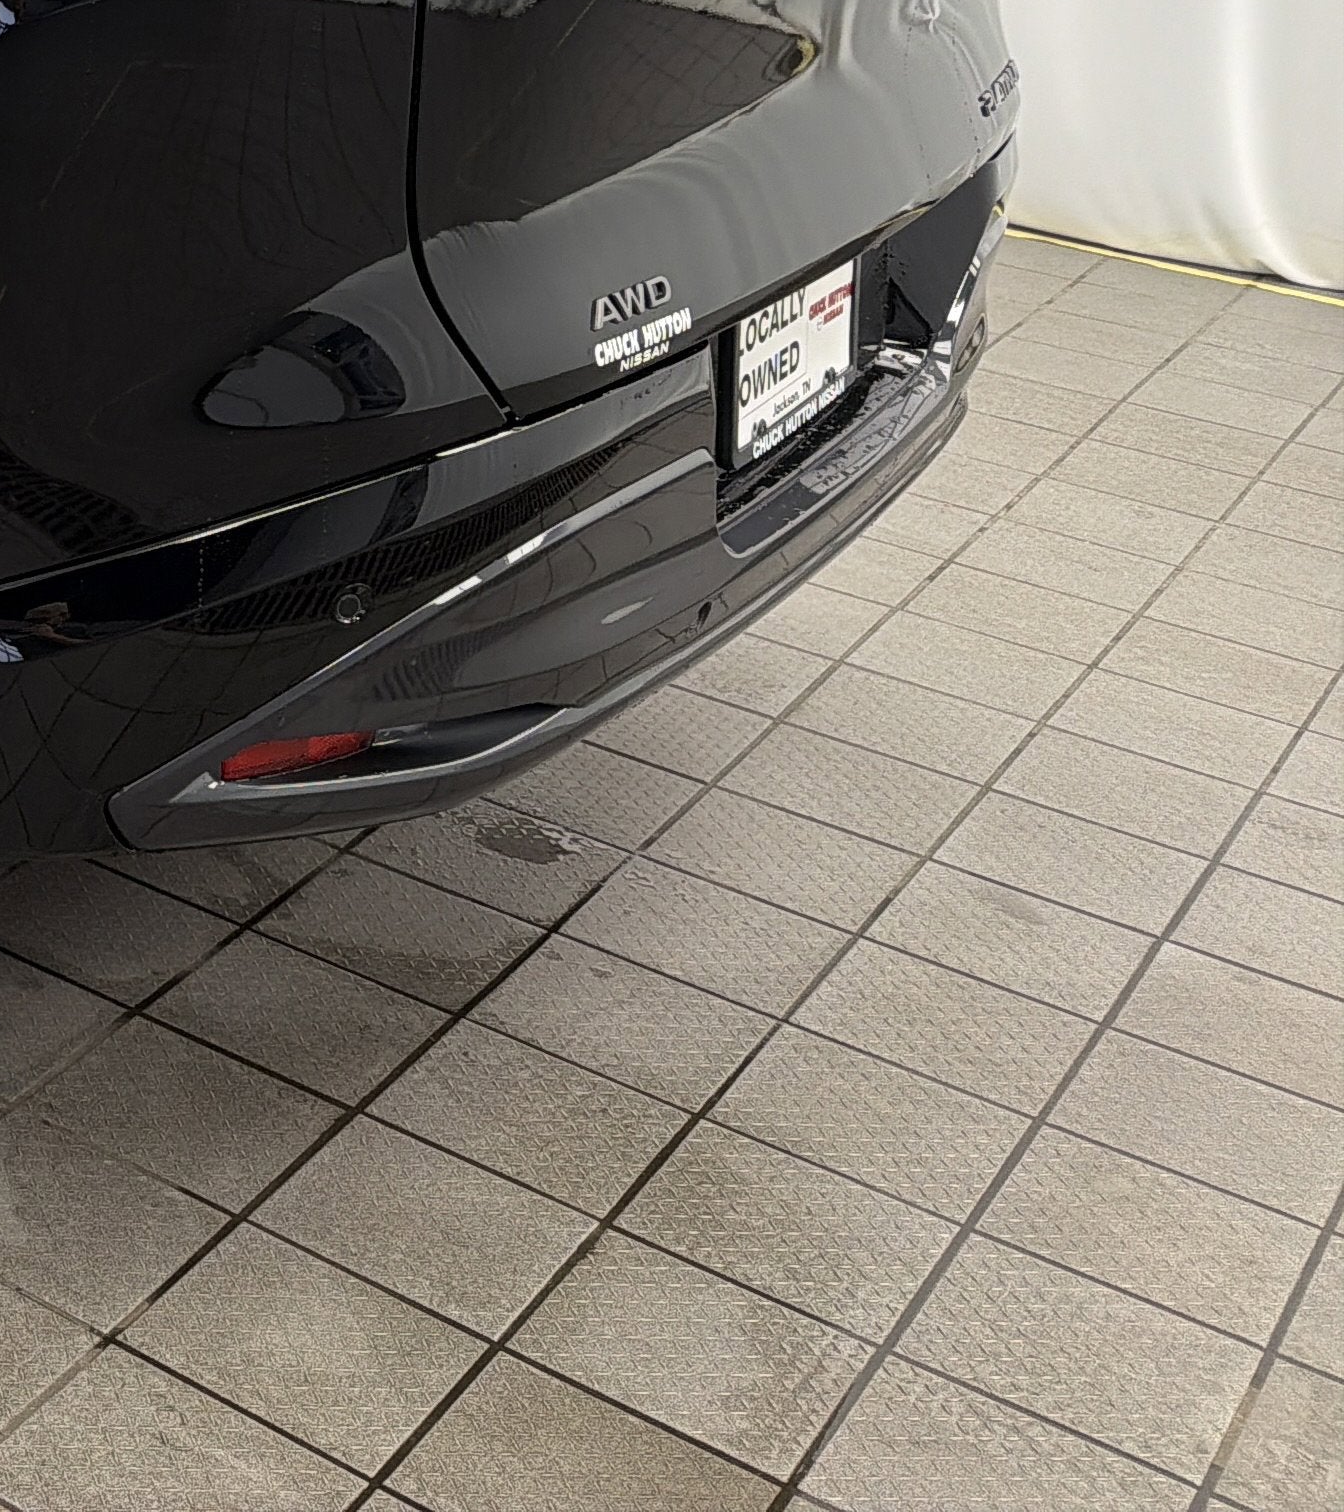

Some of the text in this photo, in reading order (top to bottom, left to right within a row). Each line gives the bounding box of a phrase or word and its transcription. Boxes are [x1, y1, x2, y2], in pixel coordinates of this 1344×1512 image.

[590, 275, 673, 332] AWD
[594, 307, 692, 367] CHUCK HUTTON
[619, 340, 670, 372] NISSAN
[740, 341, 800, 408] OWNED
[753, 376, 846, 459] CHUCK HUTTON NISSAN
